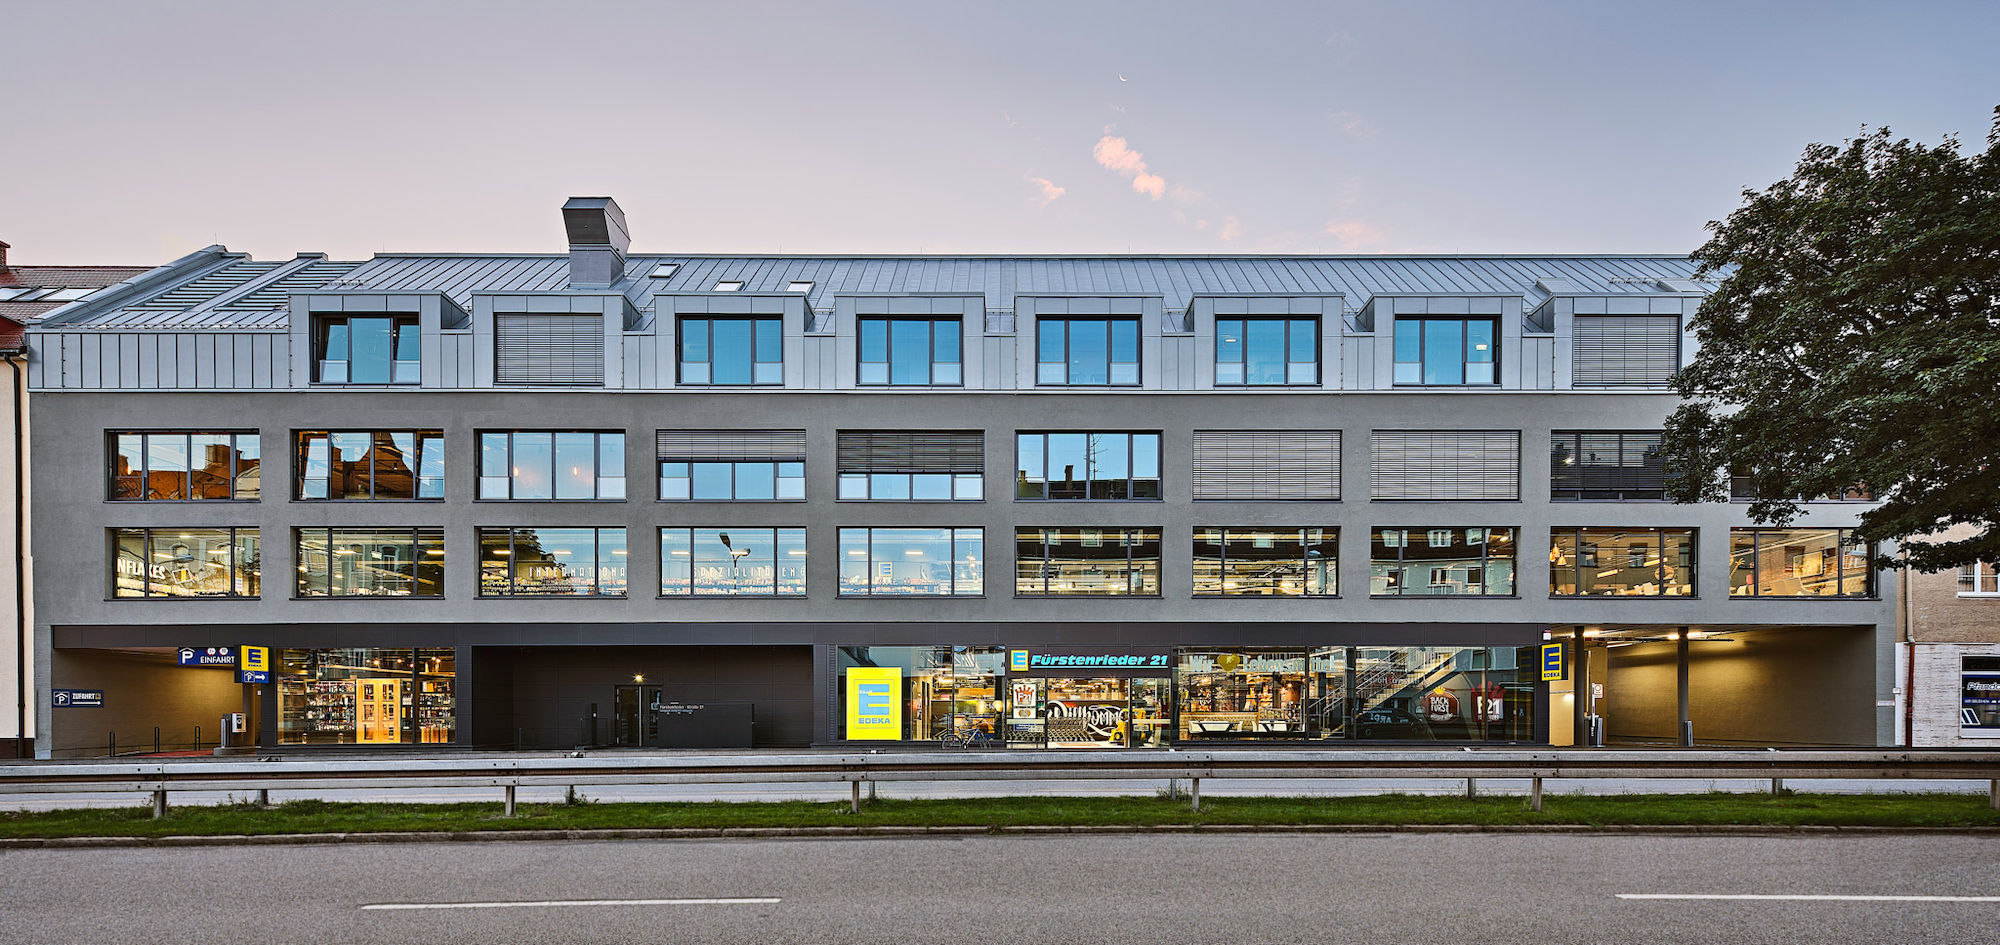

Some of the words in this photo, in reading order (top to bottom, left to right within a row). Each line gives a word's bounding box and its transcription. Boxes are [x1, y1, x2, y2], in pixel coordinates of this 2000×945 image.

[200, 656, 235, 664] EINFAHRT
[1031, 654, 1146, 666] Fürstenrieder
[1150, 655, 1168, 666] 21
[1243, 655, 1335, 673] Lebensmttel
